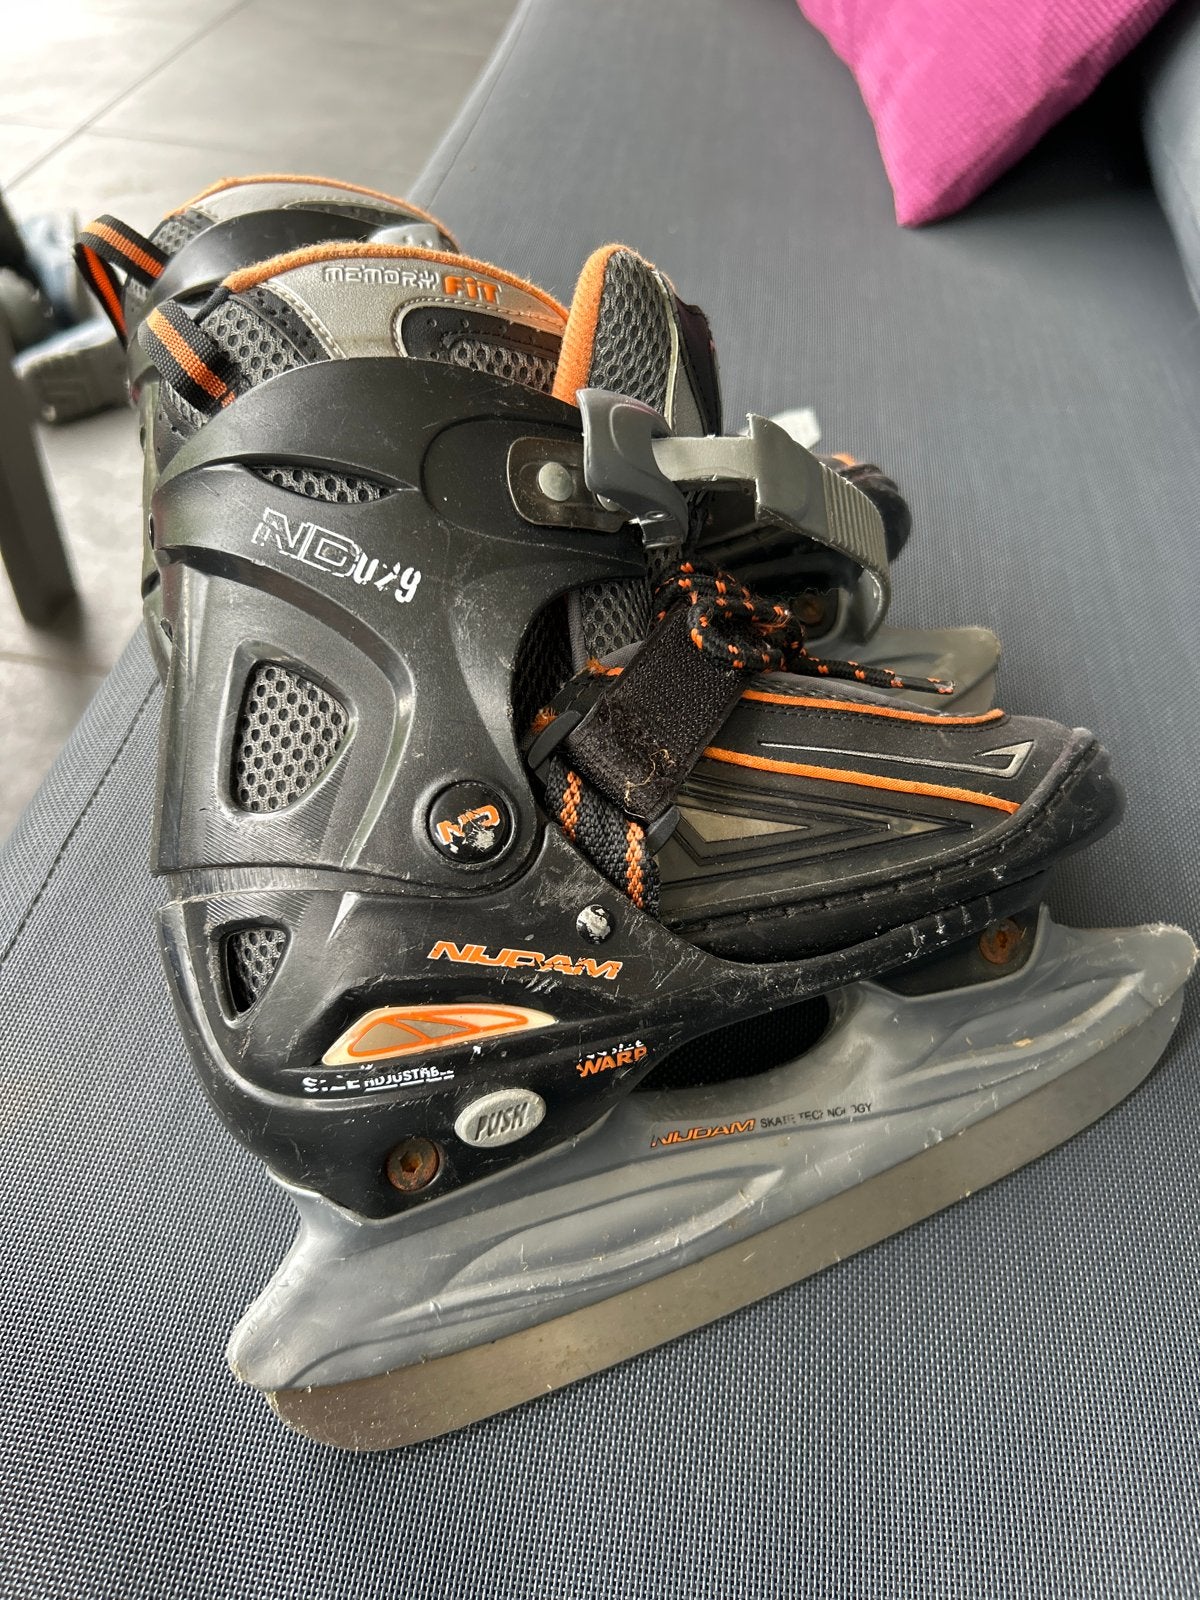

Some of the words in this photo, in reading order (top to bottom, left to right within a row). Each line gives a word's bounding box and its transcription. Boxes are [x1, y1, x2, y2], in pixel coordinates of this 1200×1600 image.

[323, 264, 440, 290] MEMORY
[427, 940, 623, 980] NIJDAM
[364, 1066, 454, 1088] ADJUSTAB
[576, 1046, 648, 1077] WARP
[474, 1102, 530, 1142] PUSH
[650, 1119, 756, 1148] NIJDAM
[798, 1102, 873, 1121] TECNOOGY
